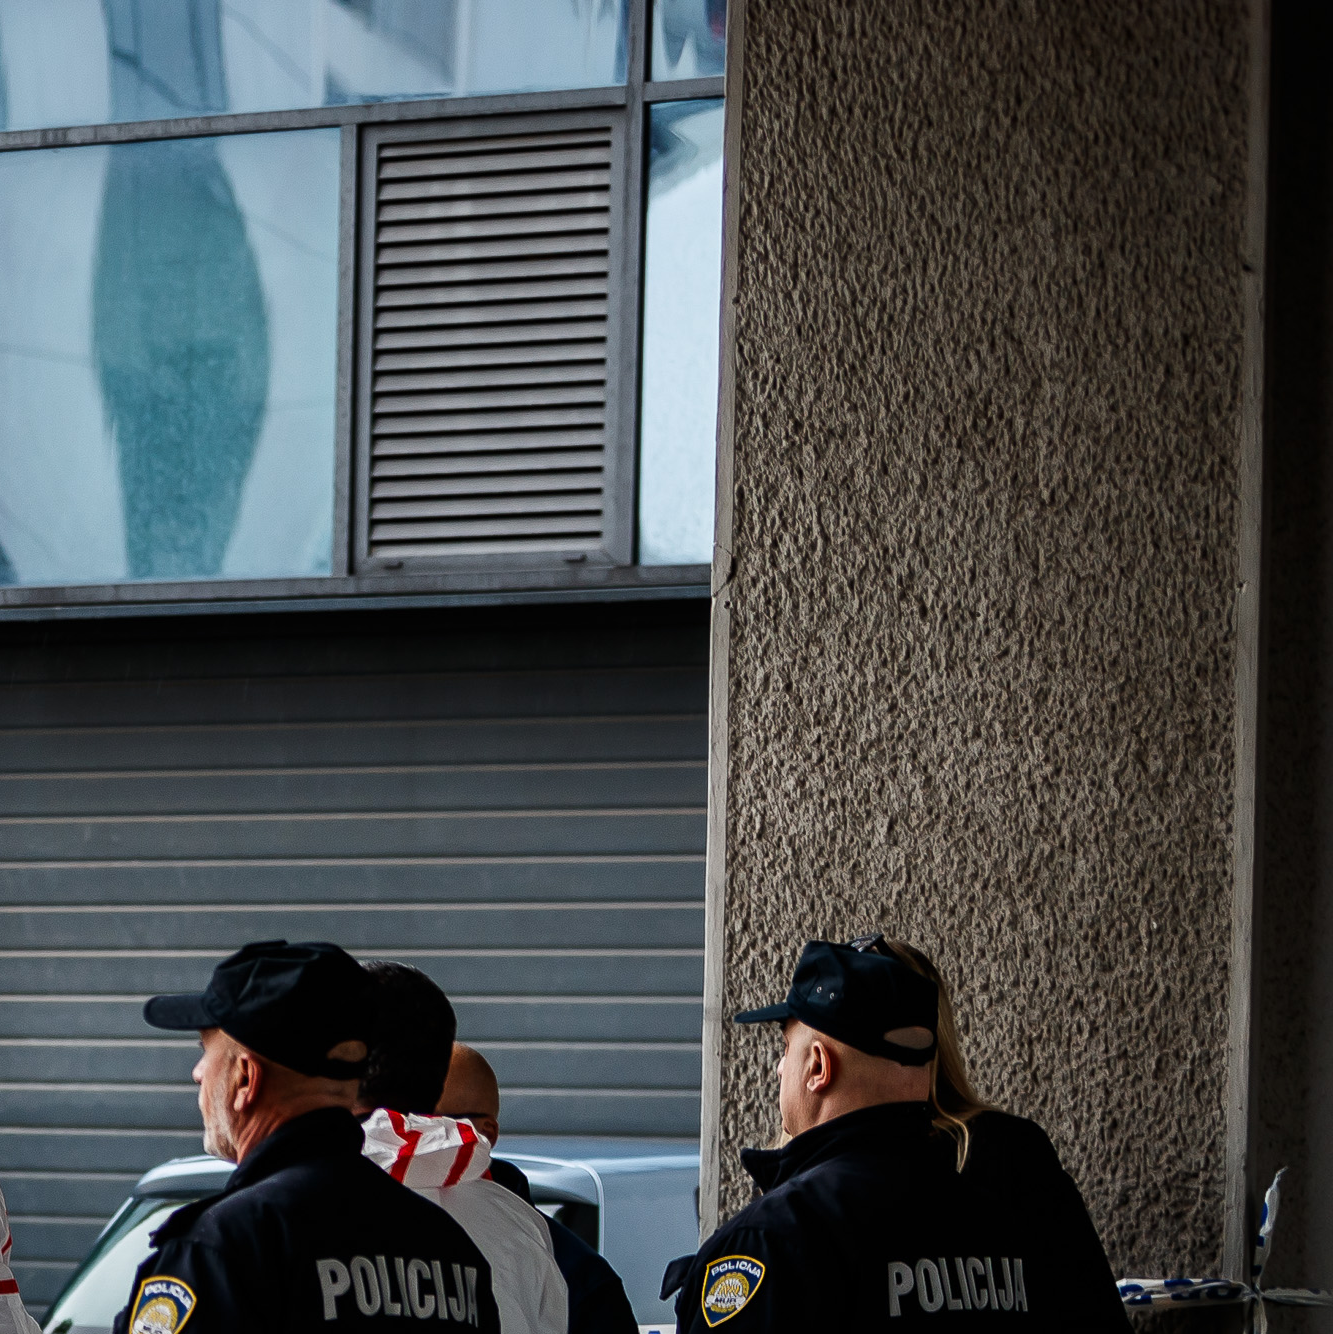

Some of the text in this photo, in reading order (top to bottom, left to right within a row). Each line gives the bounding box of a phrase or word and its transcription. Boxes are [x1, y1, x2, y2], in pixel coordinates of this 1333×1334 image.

[316, 1255, 479, 1328] POLICIJA
[711, 1260, 761, 1278] POLICIJA
[888, 1256, 1029, 1317] POLICIJA
